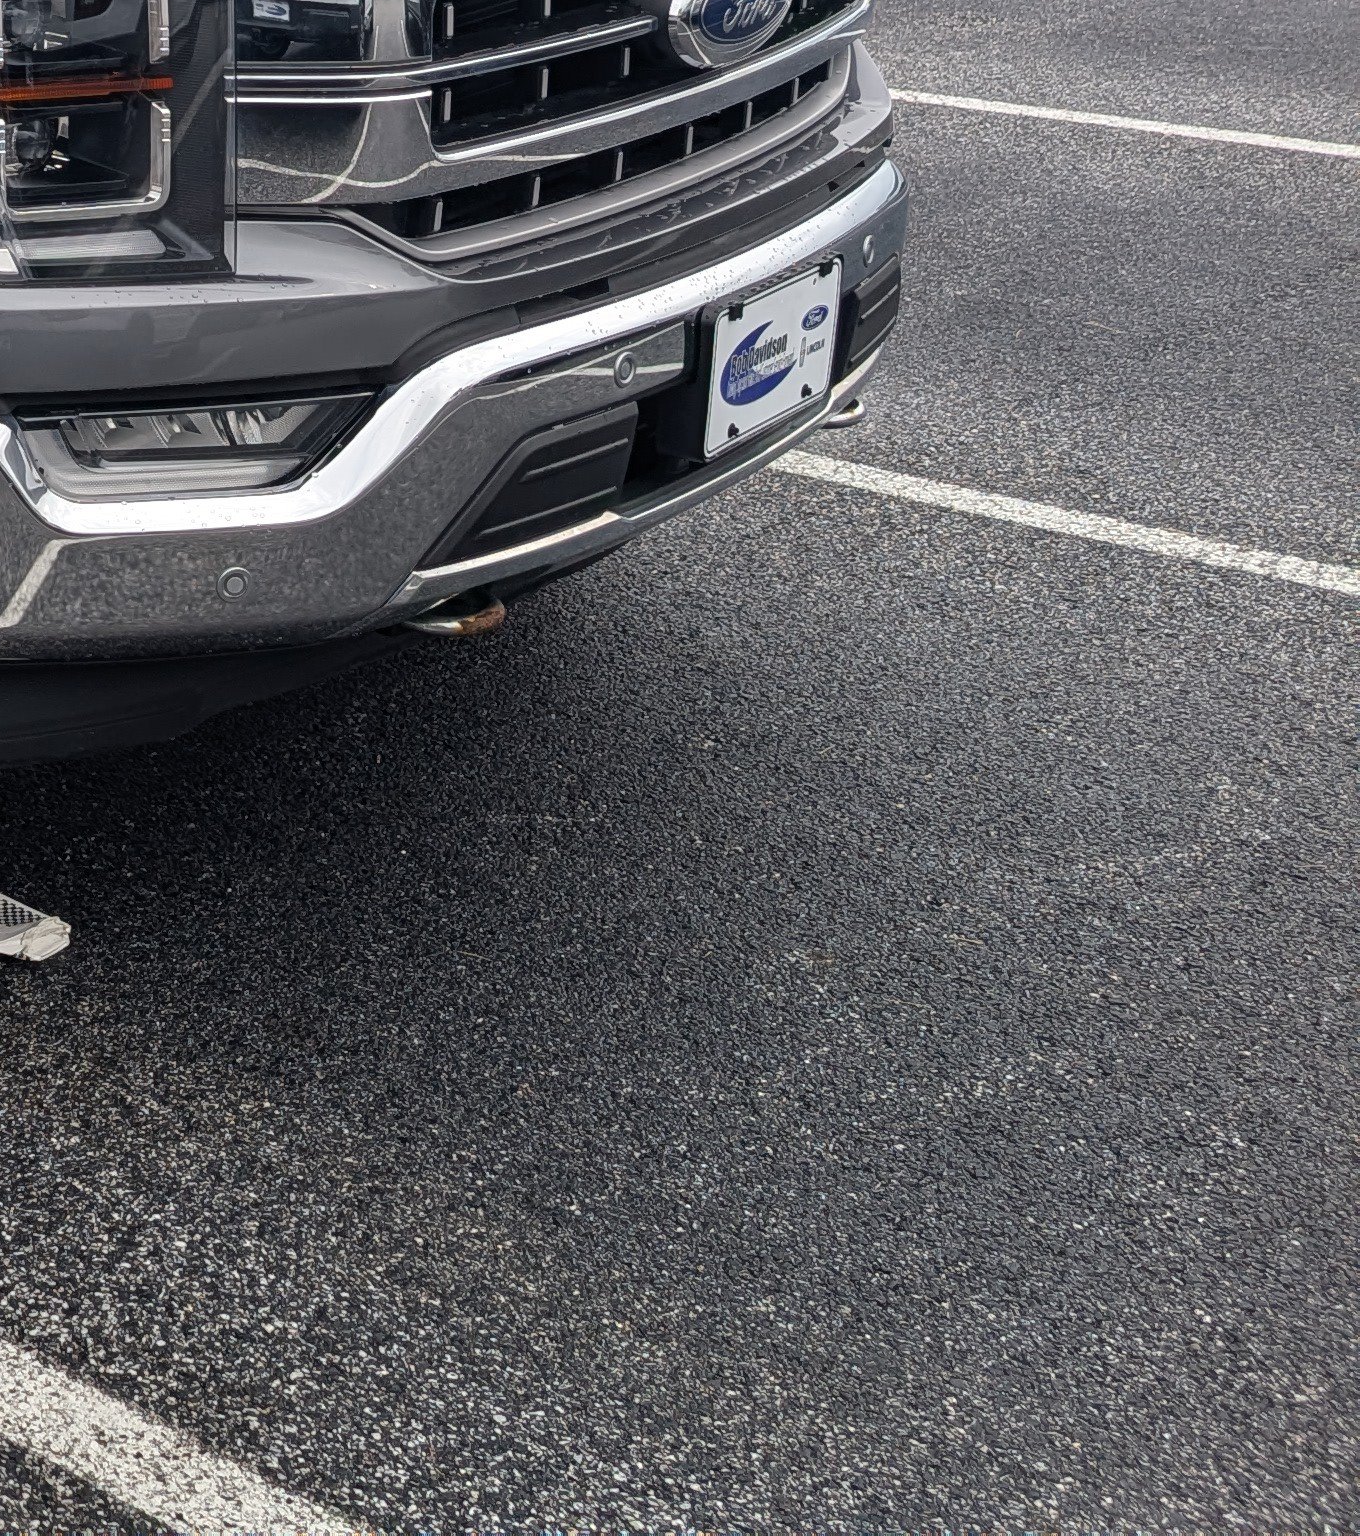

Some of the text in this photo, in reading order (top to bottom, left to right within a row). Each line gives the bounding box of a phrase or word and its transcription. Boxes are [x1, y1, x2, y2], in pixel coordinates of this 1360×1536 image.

[729, 350, 749, 382] Bob
[749, 332, 789, 369] Davidson
[807, 338, 825, 355] LINCOLN
